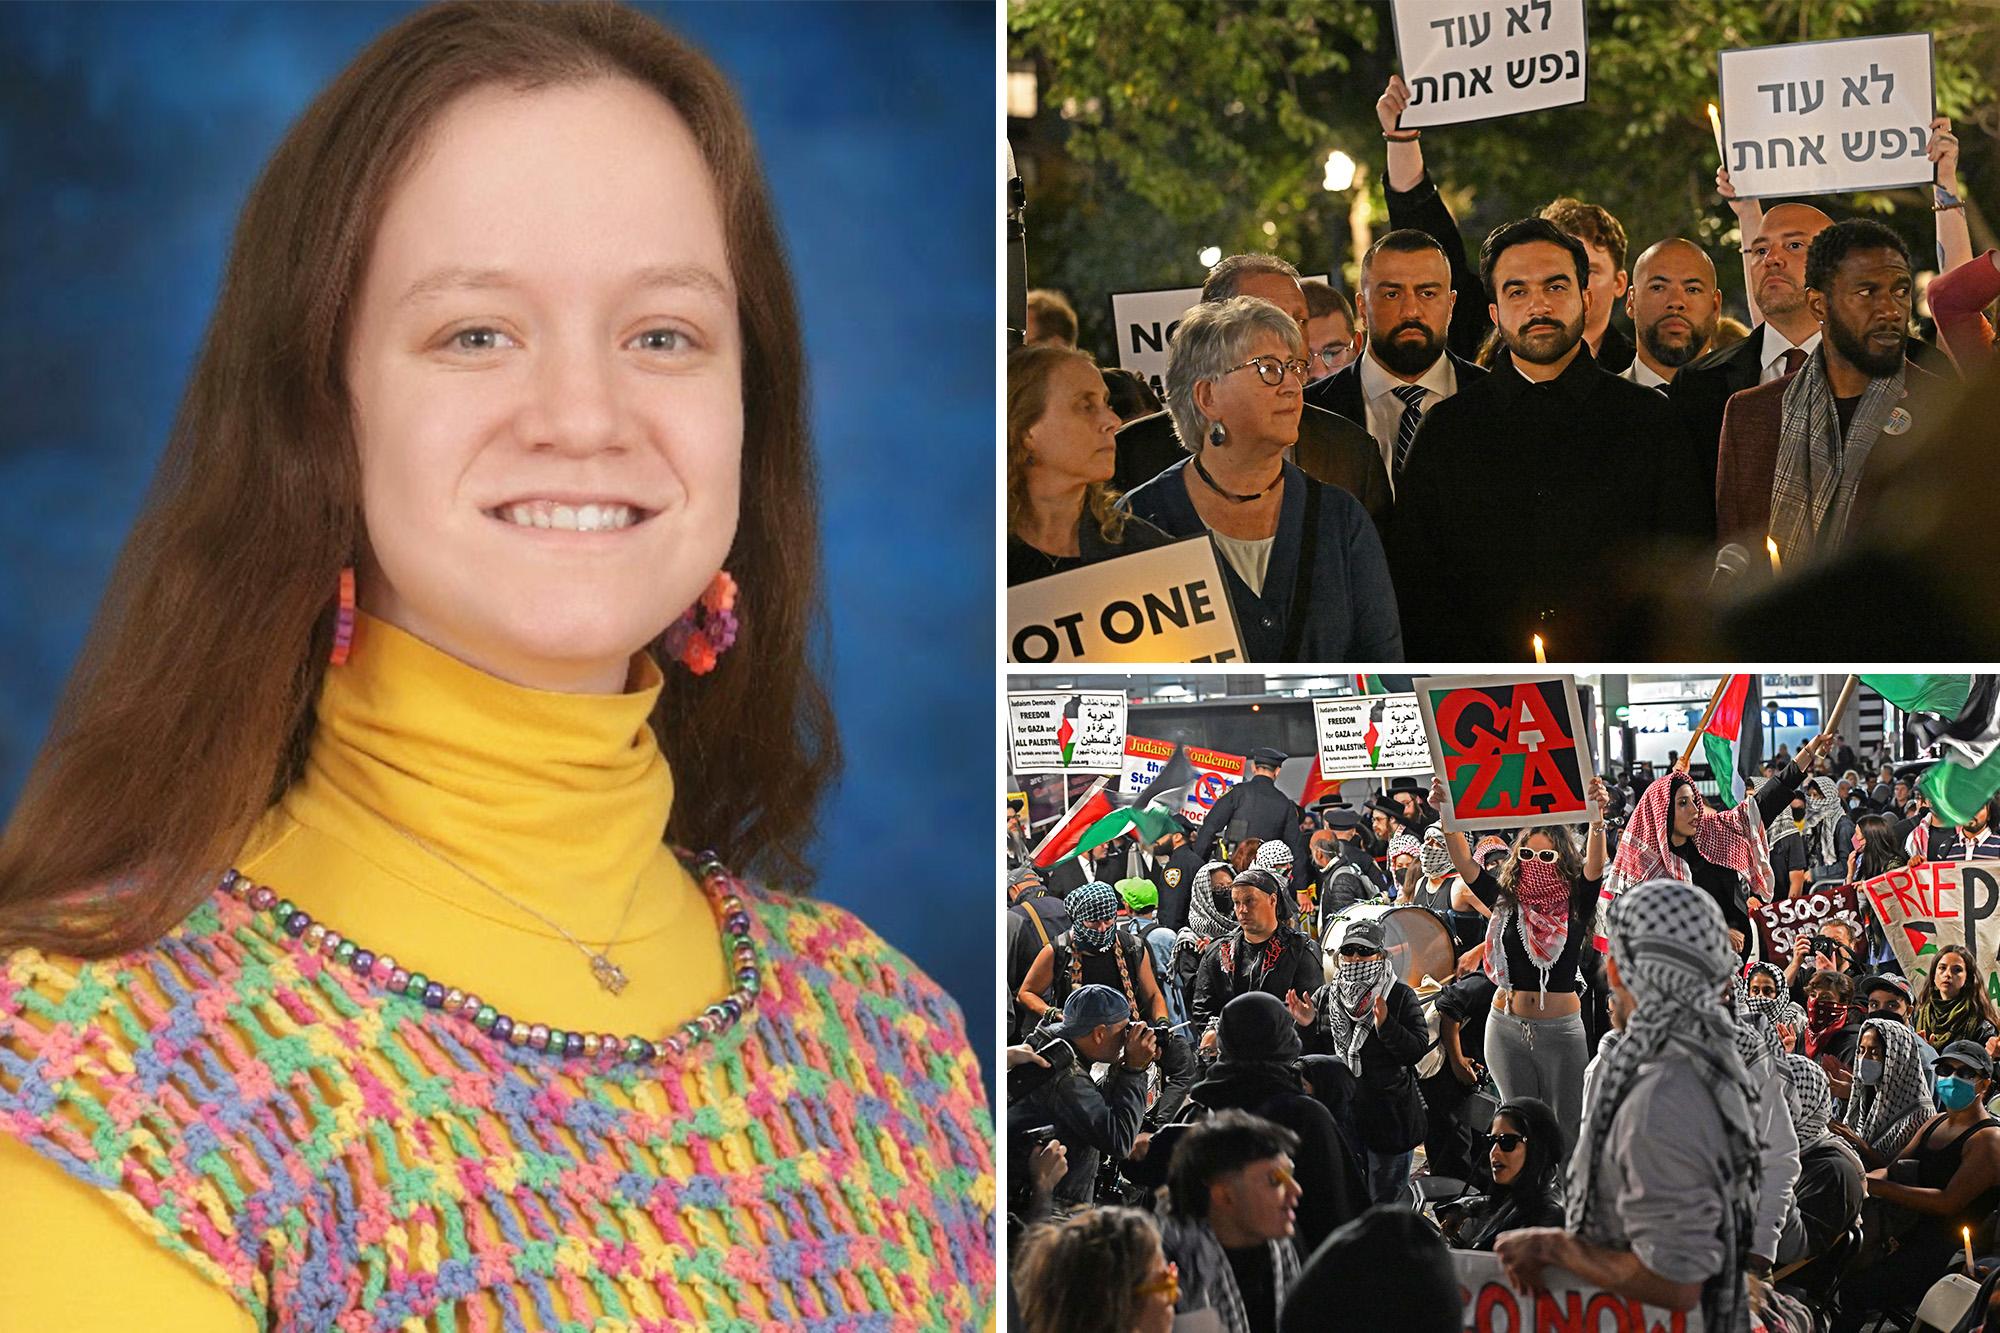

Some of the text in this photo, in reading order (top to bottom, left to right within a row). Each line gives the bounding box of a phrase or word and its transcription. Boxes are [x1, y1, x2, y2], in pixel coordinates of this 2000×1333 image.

[1430, 0, 1553, 48] לא עוד
[1409, 49, 1580, 106] נפש אחת
[1757, 63, 1895, 116] לא עוד
[1732, 126, 1928, 172] נפש אחת
[1008, 579, 1216, 663] OT ONE
[1020, 711, 1050, 719] FREEDOM
[1088, 708, 1115, 721] الحرية
[1328, 716, 1356, 725] FREEDOM
[1391, 711, 1416, 723] الحرية
[1092, 722, 1105, 732] غزة
[1396, 725, 1408, 734] غزة
[1029, 738, 1060, 746] PALESTINE
[1081, 734, 1121, 746] كل فلسطين
[1385, 735, 1415, 748] فلسطين
[1335, 743, 1367, 751] PALESTINE
[1866, 862, 1959, 925] FREE
[1534, 1288, 1688, 1333] NOW
